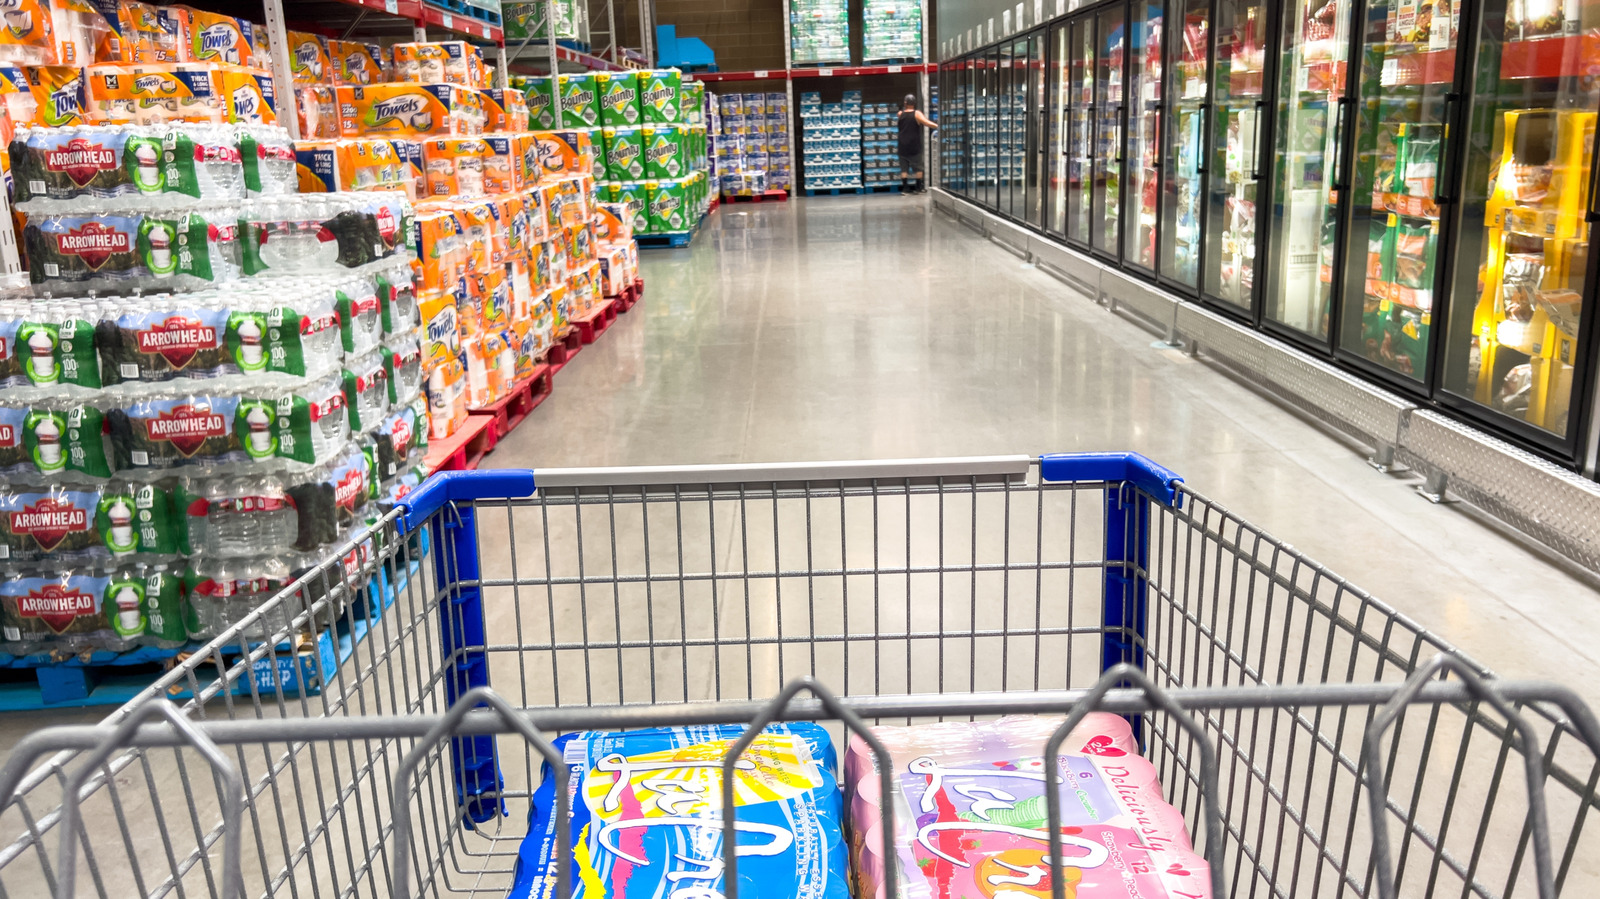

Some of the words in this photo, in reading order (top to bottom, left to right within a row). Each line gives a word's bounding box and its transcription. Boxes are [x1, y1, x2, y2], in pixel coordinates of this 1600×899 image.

[505, 3, 536, 22] Bounty
[201, 30, 231, 52] Towels
[135, 78, 160, 89] Towels
[561, 90, 594, 111] Bounty
[601, 88, 635, 109] Bounty
[642, 86, 675, 107] Bounty
[374, 99, 418, 122] Towels
[49, 150, 113, 166] ARROWHEAD
[607, 144, 640, 165] Bounty
[645, 142, 678, 163] Bounty
[650, 197, 680, 215] Bounty
[62, 234, 126, 249] ARROWHEAD
[427, 312, 454, 341] Towels
[143, 329, 213, 346] ARROWHEAD
[151, 416, 222, 434] ARROWHEAD
[137, 490, 150, 500] 40
[15, 510, 83, 527] ARROWHEAD
[22, 596, 91, 611] ARROWHEAD
[1091, 742, 1106, 753] 24
[1079, 771, 1094, 779] 6
[1076, 789, 1100, 821] Cucumber
[1102, 766, 1172, 852] Deliciously
[794, 803, 809, 875] SPARKLING
[806, 801, 819, 861] NATURALLY
[1101, 831, 1129, 872] Strawberry
[1131, 861, 1150, 875] 12
[809, 868, 823, 899] ESSE
